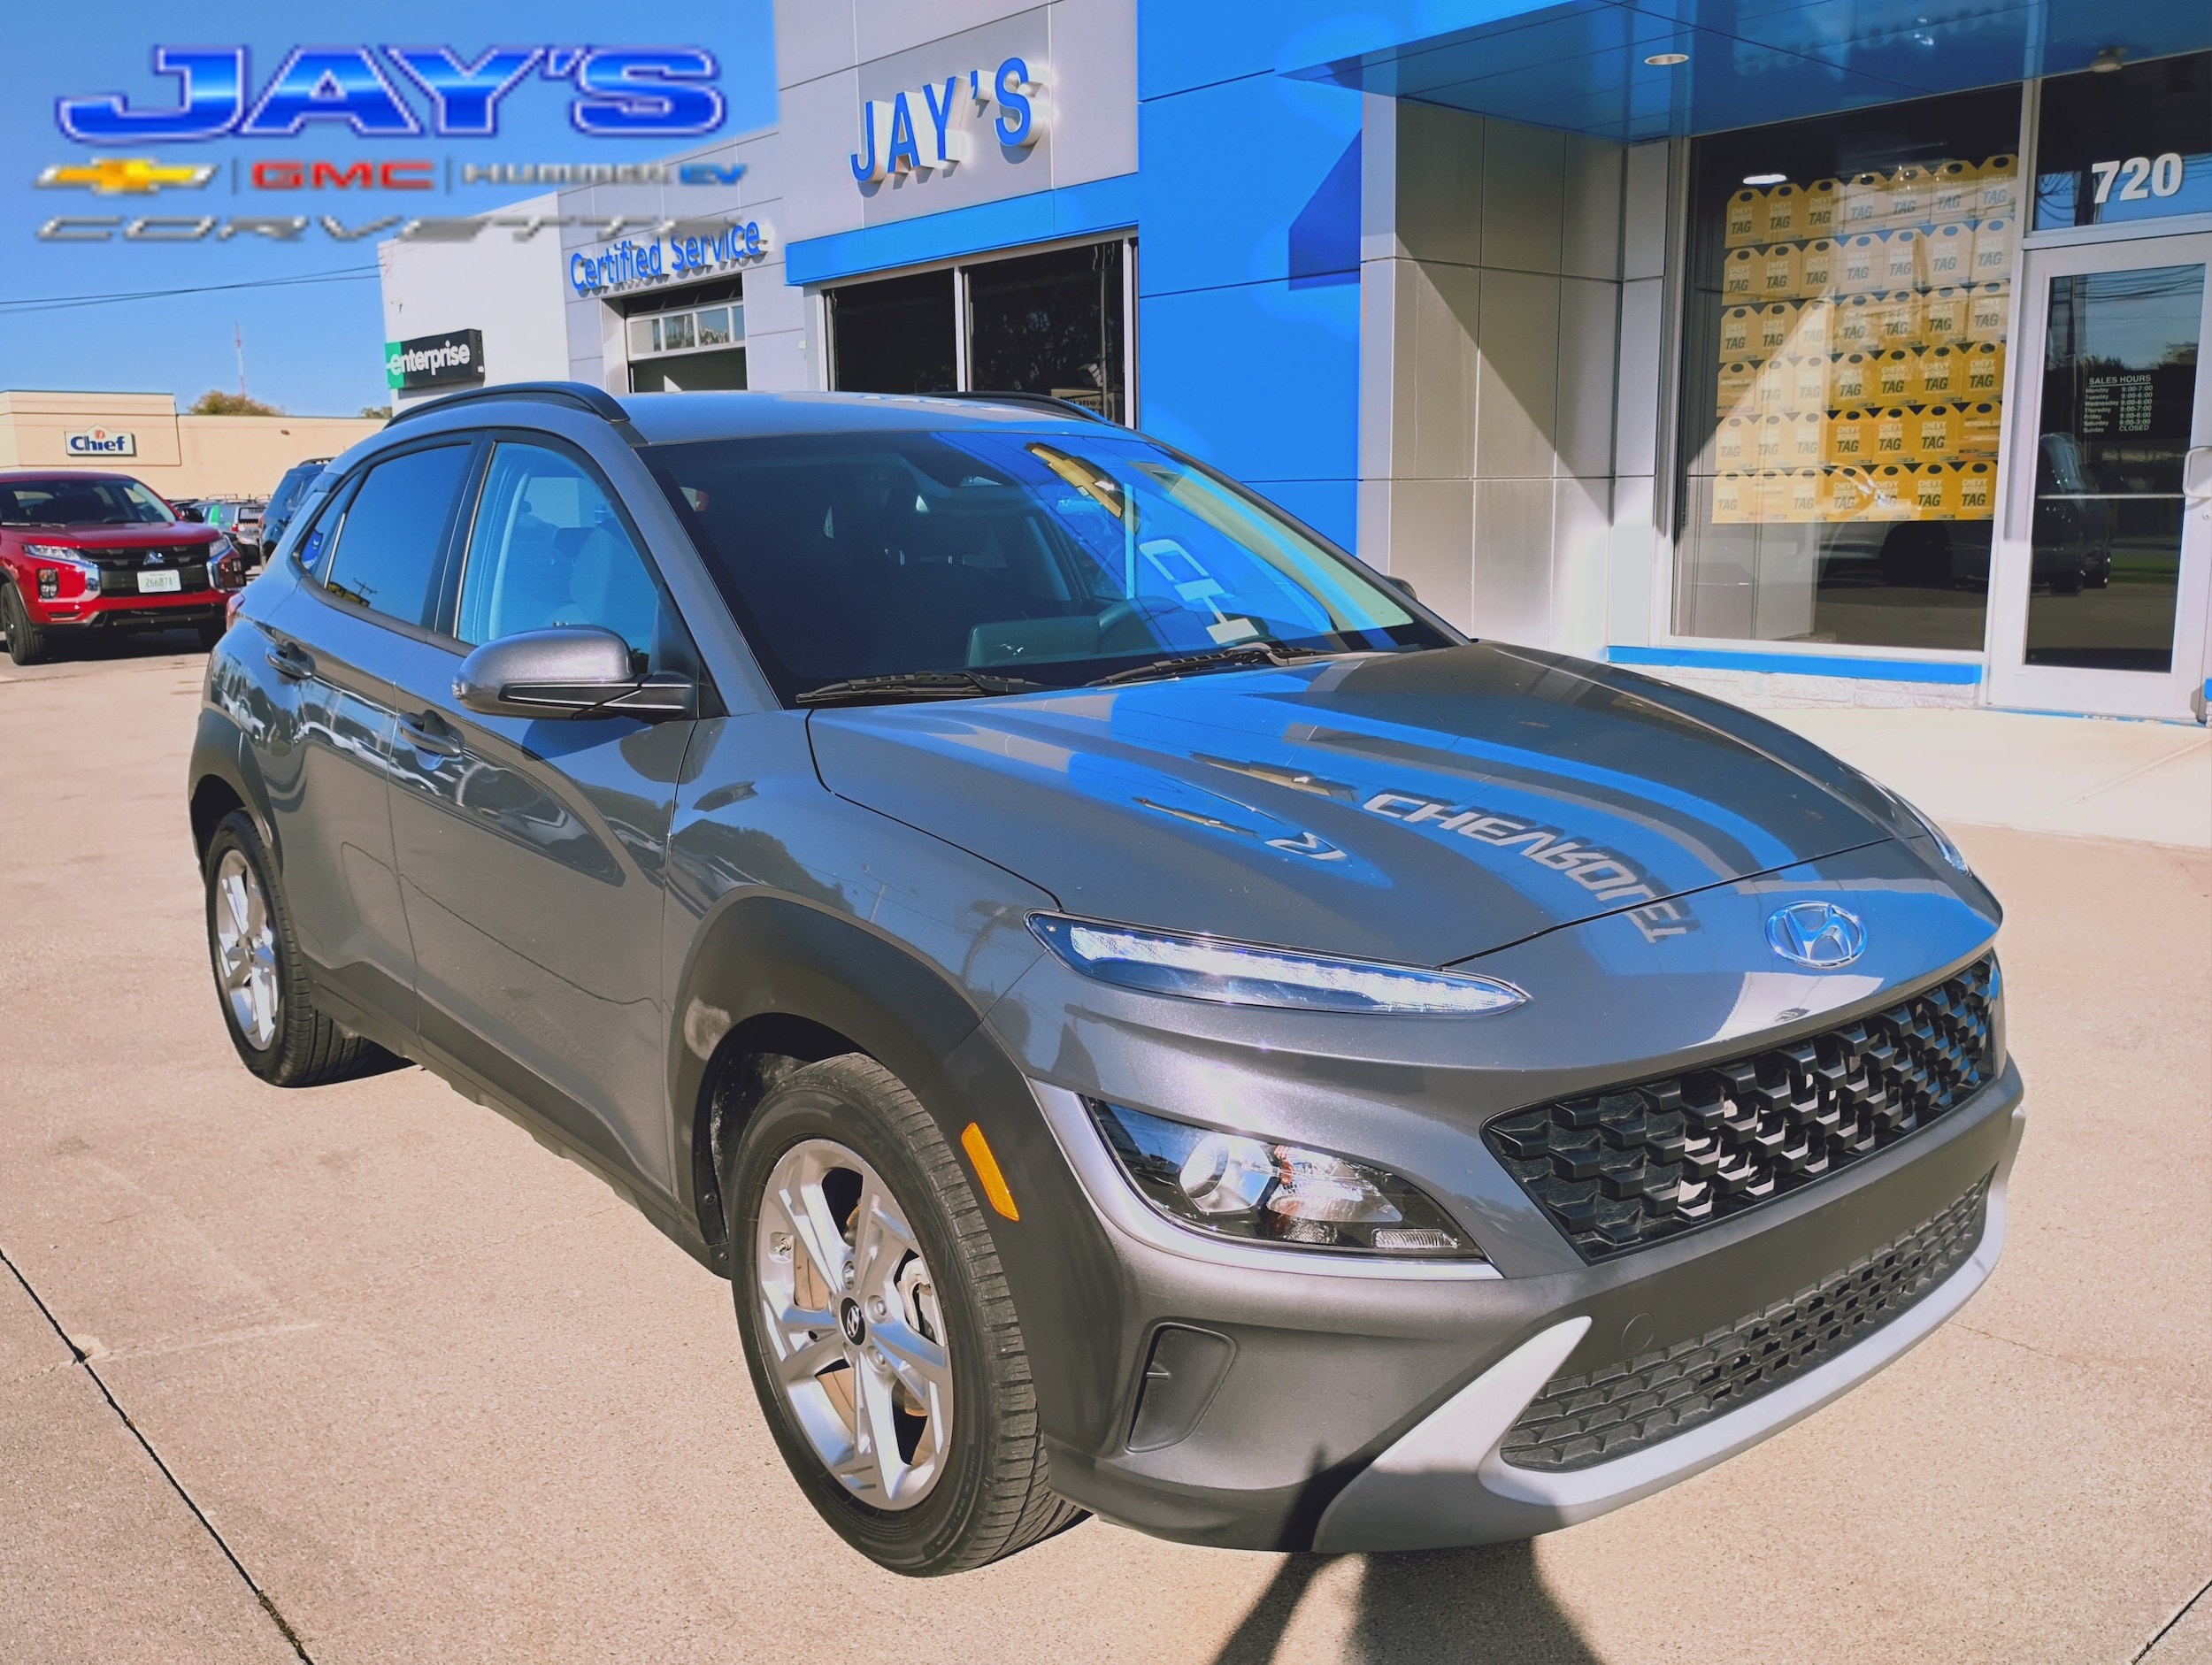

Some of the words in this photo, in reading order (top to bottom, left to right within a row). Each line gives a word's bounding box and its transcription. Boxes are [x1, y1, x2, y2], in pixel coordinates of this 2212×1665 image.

[850, 57, 1032, 183] JAY'S
[2092, 152, 2183, 204] 720
[1938, 196, 1961, 211] TAG
[1983, 189, 2007, 204] TAG
[1851, 205, 1873, 219] TAG
[1893, 200, 1916, 214] TAG
[1770, 216, 1790, 230] TAG
[1809, 211, 1831, 226] TAG
[1732, 220, 1751, 234] TAG
[570, 236, 663, 291] Certified
[670, 218, 760, 272] Service
[1978, 251, 2002, 266] TAG
[1890, 263, 1911, 277] TAG
[1933, 257, 1956, 272] TAG
[1806, 271, 1827, 285] TAG
[1847, 266, 1869, 280] TAG
[1728, 279, 1748, 293] TAG
[1766, 275, 1786, 289] TAG
[1929, 318, 1952, 332] TAG
[1975, 314, 1999, 328] TAG
[1844, 326, 1865, 339] TAG
[1886, 322, 1908, 335] TAG
[1763, 334, 1783, 347] TAG
[1803, 329, 1824, 343] TAG
[1725, 337, 1745, 350] TAG
[388, 340, 470, 376] enterprise
[1924, 377, 1948, 391] TAG
[1970, 374, 1993, 388] TAG
[2089, 376, 2117, 385] SALES
[2120, 374, 2152, 383] HOURS
[1801, 386, 1820, 399] TAG
[1840, 383, 1862, 397] TAG
[1882, 380, 1904, 394] TAG
[1761, 388, 1781, 403] TAG
[70, 436, 125, 451] Chief
[1797, 441, 1818, 455] TAG
[1837, 441, 1859, 453] TAG
[1879, 438, 1901, 451] TAG
[1922, 436, 1945, 449] TAG
[1721, 446, 1741, 457] TAG
[1758, 443, 1778, 457] TAG
[1962, 478, 1988, 487] CHEVY
[1717, 499, 1737, 511] TAG
[1793, 497, 1814, 510] TAG
[1833, 495, 1855, 510] TAG
[1917, 494, 1941, 507] TAG
[1962, 493, 1985, 507] TAG
